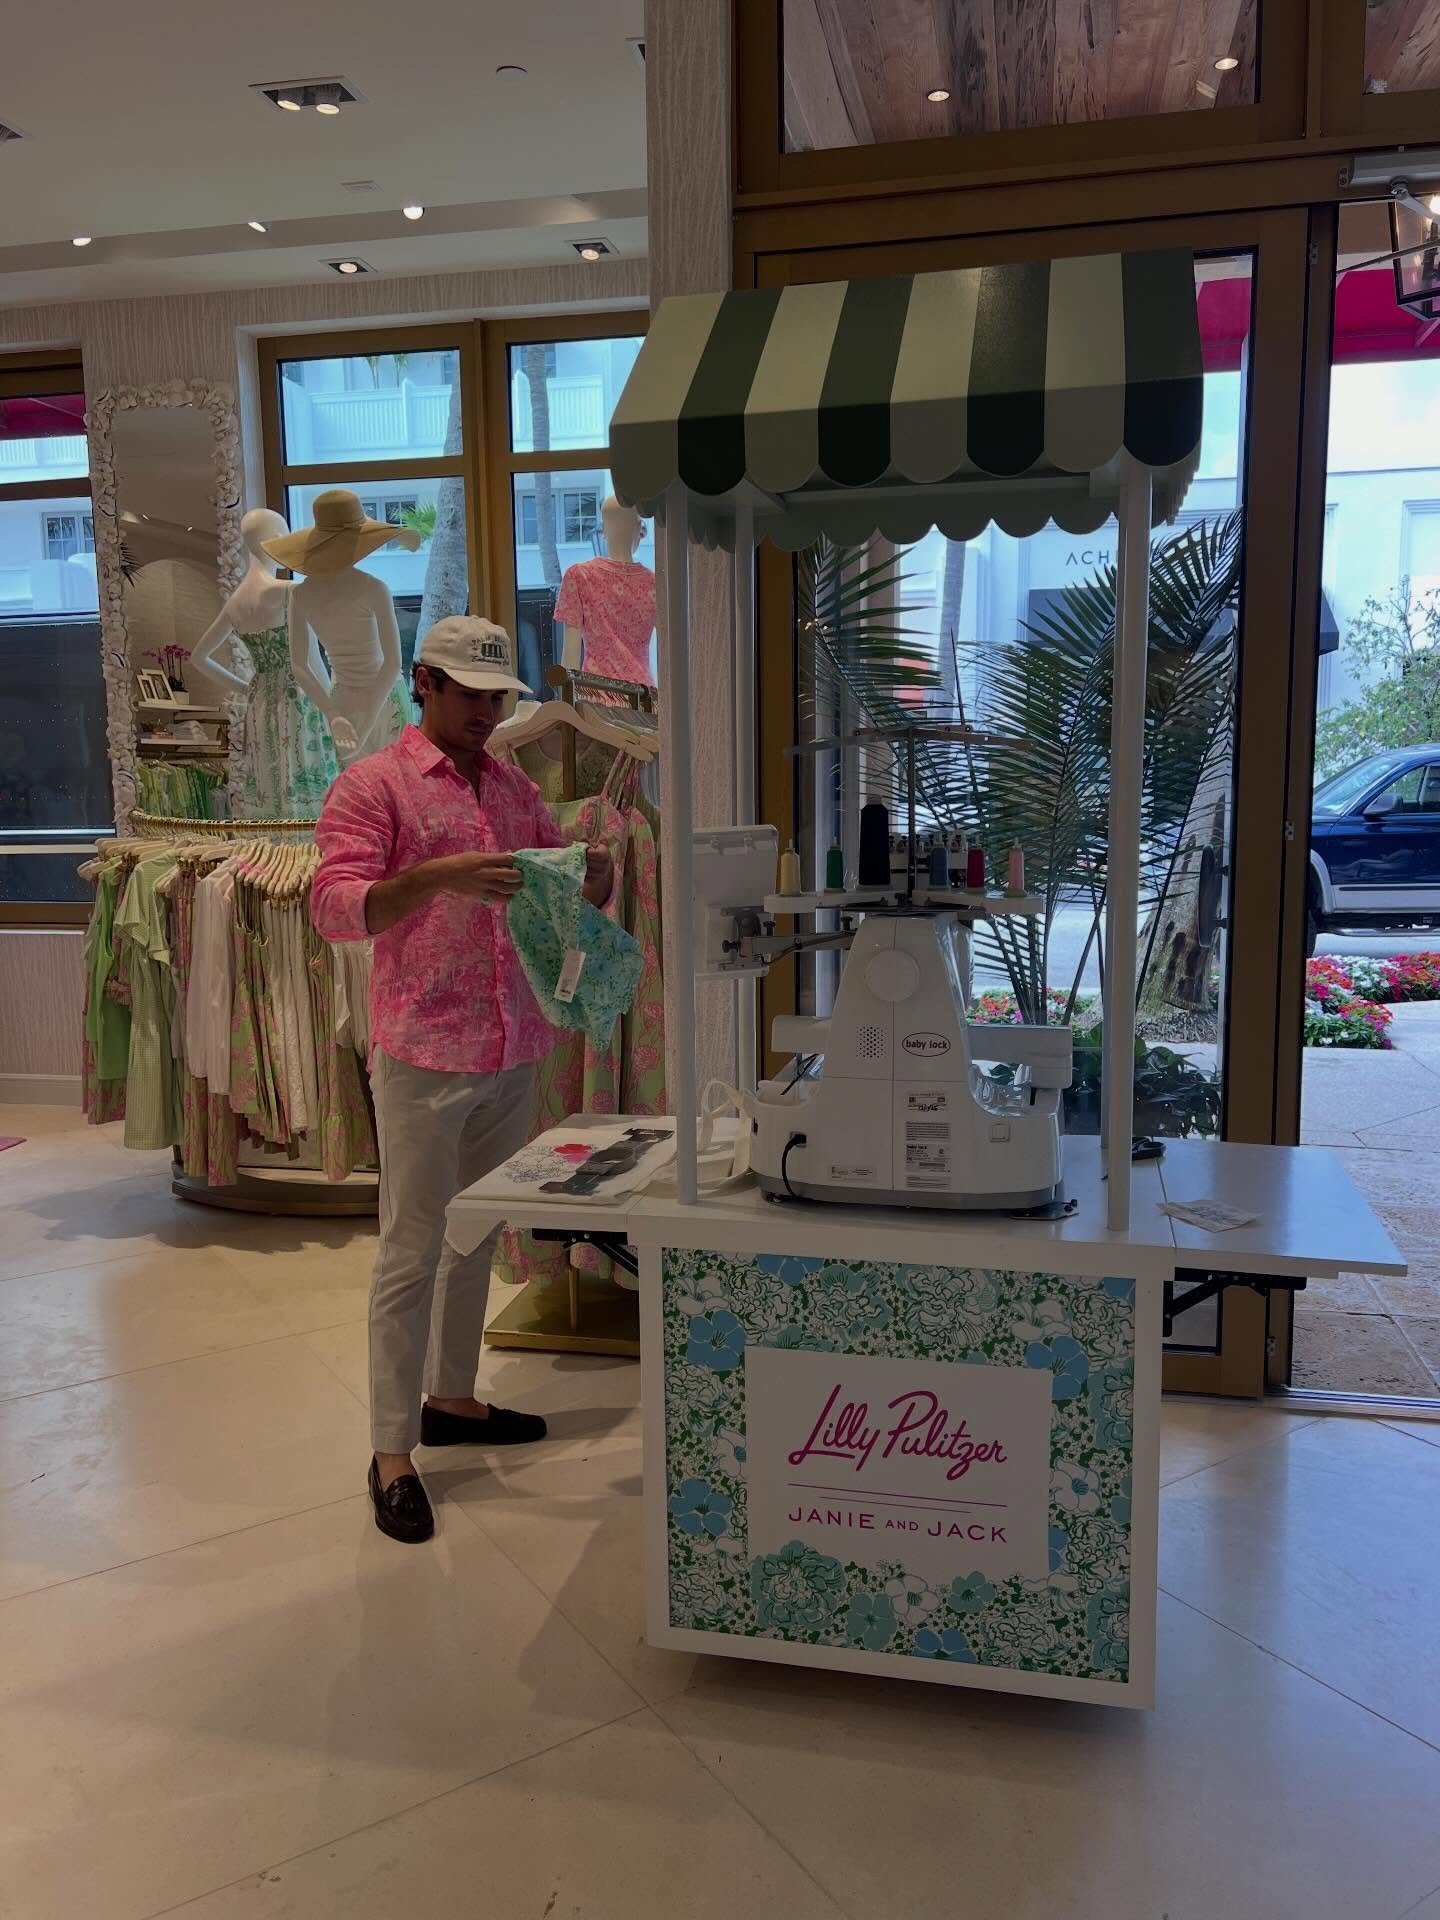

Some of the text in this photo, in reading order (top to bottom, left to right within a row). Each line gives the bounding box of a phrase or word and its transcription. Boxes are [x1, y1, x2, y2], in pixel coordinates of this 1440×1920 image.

[1066, 550, 1118, 566] ACH
[905, 1039, 948, 1050] baby lock
[787, 1383, 1008, 1481] Lilly Pulitzer
[788, 1507, 1008, 1543] JANIE AND JACK
